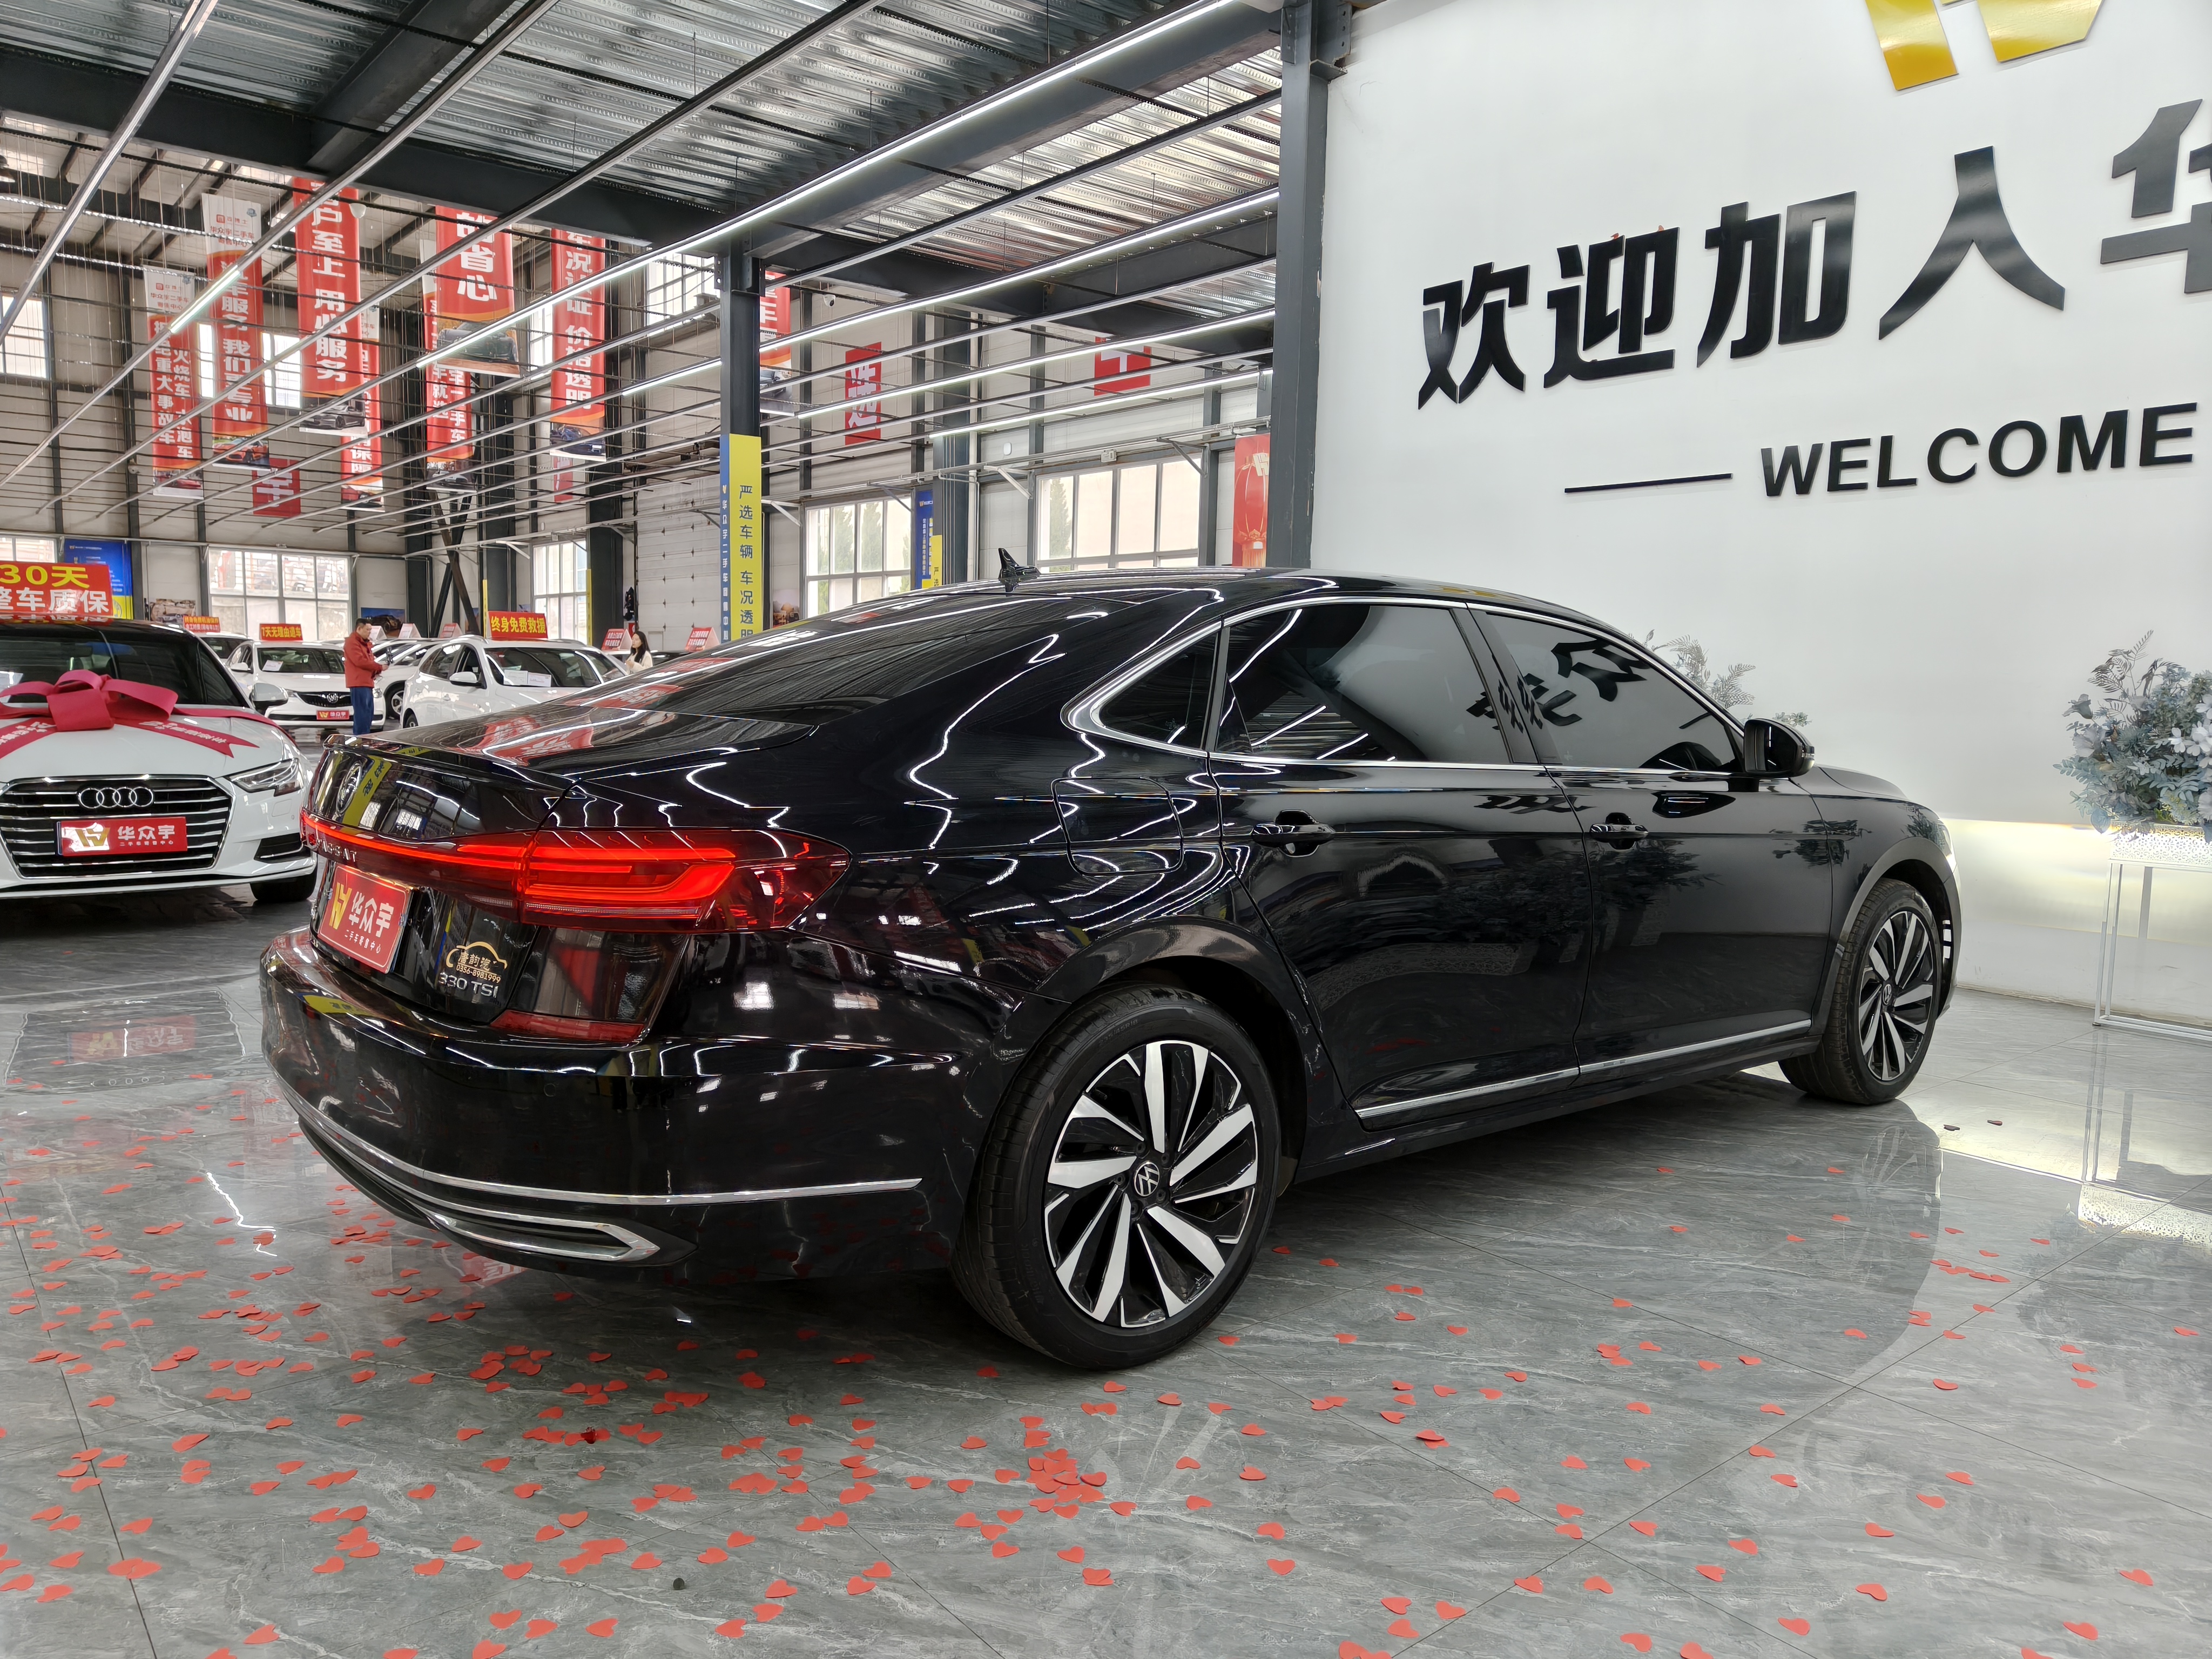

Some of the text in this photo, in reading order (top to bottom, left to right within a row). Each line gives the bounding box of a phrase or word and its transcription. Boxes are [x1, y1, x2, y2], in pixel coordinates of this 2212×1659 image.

[314, 288, 348, 382] 用心服务
[565, 325, 592, 409] 价格透明
[1761, 402, 2197, 497] WELCOME
[739, 484, 754, 638] 严选车辆 车况透明
[0, 564, 90, 588] 30天
[261, 626, 301, 637] 7天无理由退车
[491, 616, 546, 633] 终身免费救援
[118, 825, 175, 840] 华众宇
[349, 891, 394, 938] 华众宇
[456, 964, 501, 984] 0356-8981999
[458, 952, 498, 971] 唐韵汽
[438, 971, 499, 999] 330 TSI
